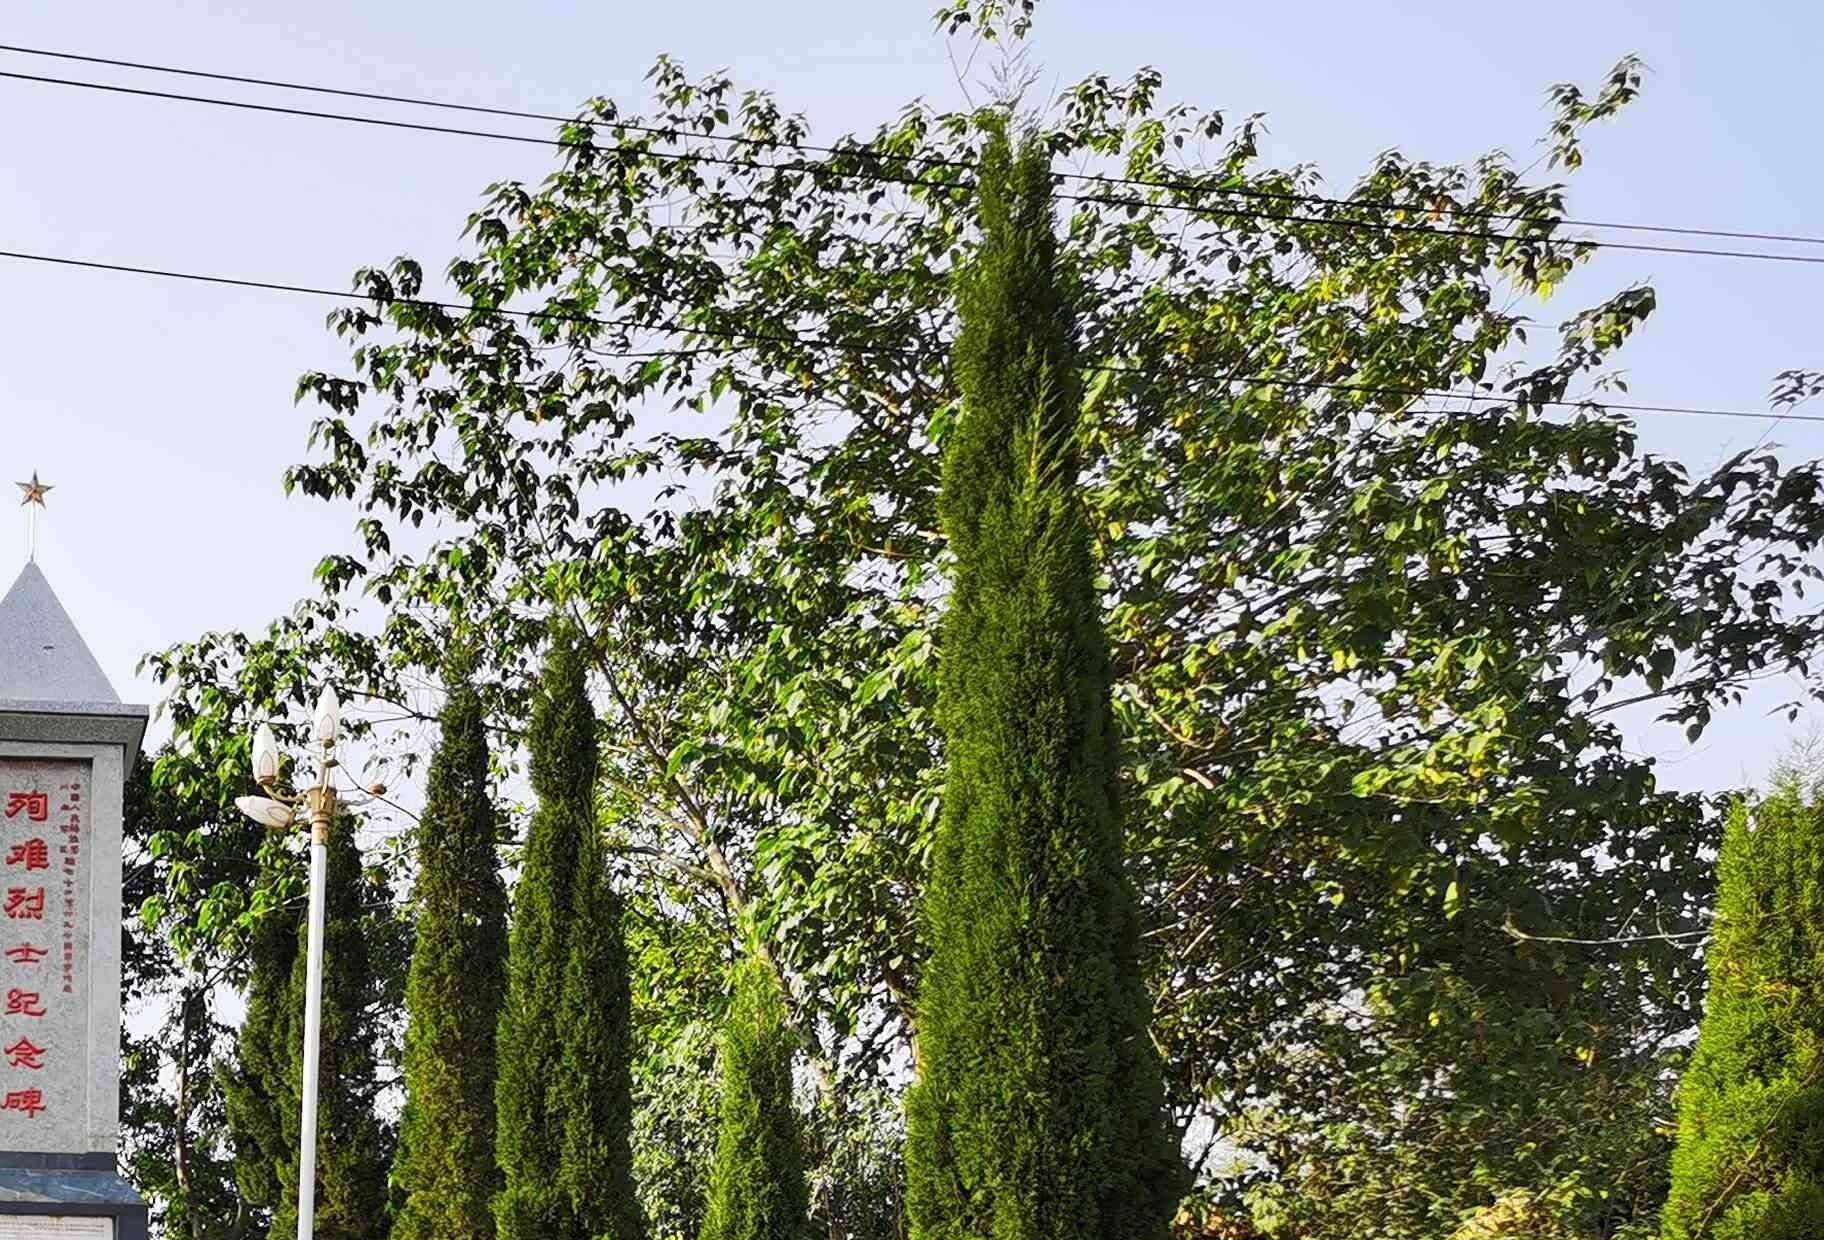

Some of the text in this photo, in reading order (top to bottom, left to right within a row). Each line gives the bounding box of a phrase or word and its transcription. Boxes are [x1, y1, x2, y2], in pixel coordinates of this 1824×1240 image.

[0, 789, 50, 1119] 殉难烈士纪念碑
